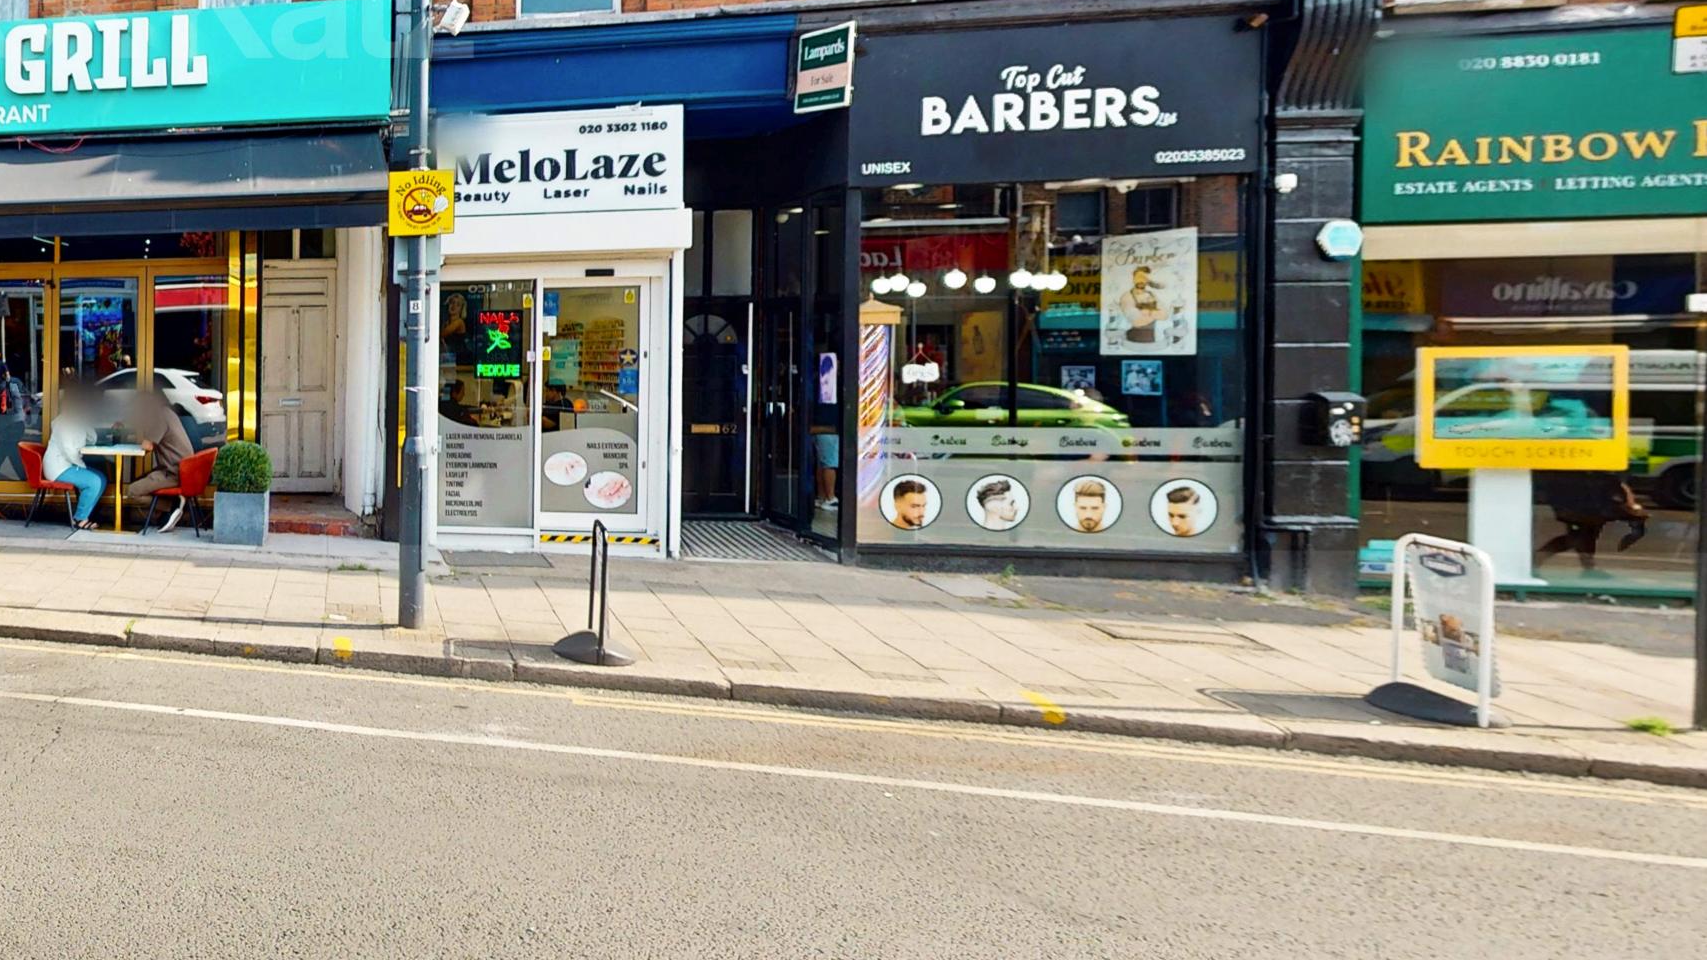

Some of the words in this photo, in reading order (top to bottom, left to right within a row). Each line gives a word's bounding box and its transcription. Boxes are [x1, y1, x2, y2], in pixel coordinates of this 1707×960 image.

[3, 14, 209, 95] GRILL
[803, 37, 845, 61] Lampards
[1000, 65, 1041, 93] Top
[1046, 64, 1087, 89] Cut
[920, 85, 1161, 136] BARBERS
[579, 123, 603, 135] 020
[1395, 130, 1677, 168] RAINBOW
[454, 147, 667, 186] MeloLaze
[861, 161, 911, 175] UNISEX
[396, 182, 412, 197] No
[413, 174, 447, 196] Idling
[453, 191, 511, 204] Beauty
[543, 188, 591, 200] Laser
[623, 182, 668, 196] Nails
[1393, 181, 1457, 195] ESTATE
[1462, 178, 1534, 193] AGENTS
[1554, 175, 1636, 190] LETTING
[478, 311, 520, 325] NAILS
[476, 363, 521, 377] PEDICURE
[1454, 446, 1515, 458] TOUCH
[1525, 446, 1594, 459] SCREEN
